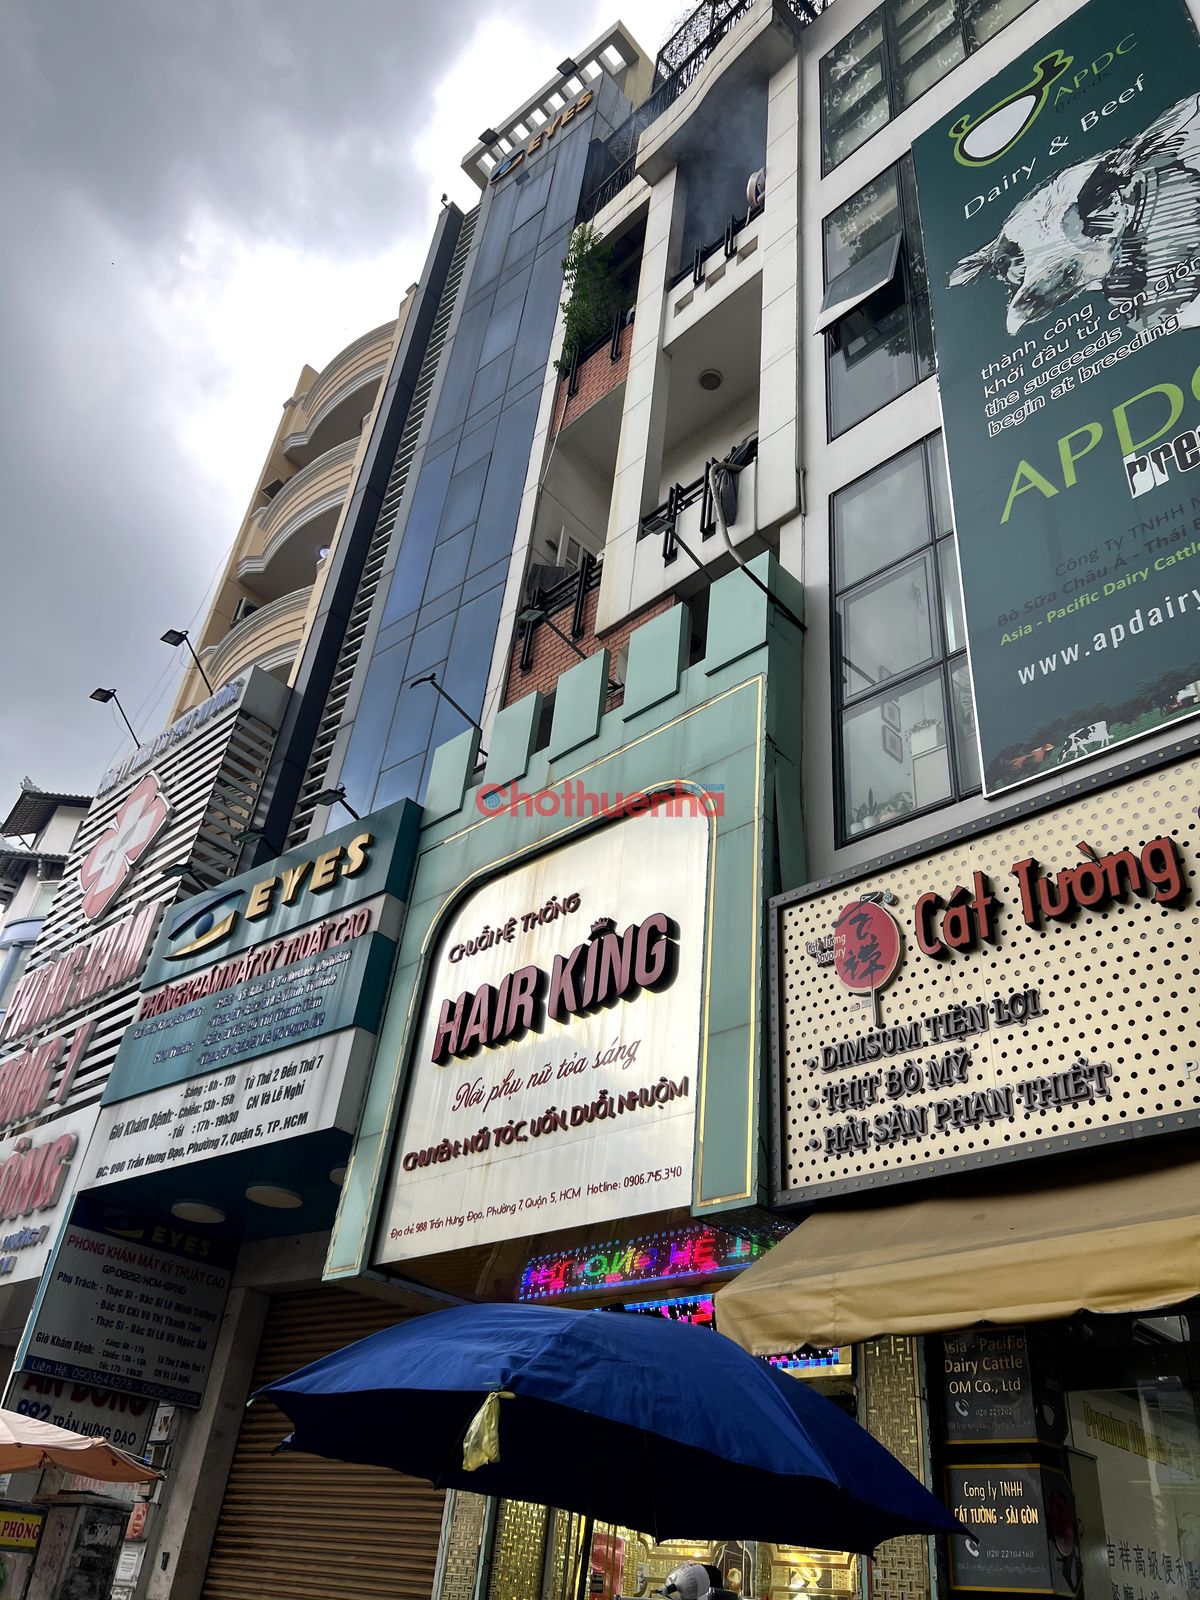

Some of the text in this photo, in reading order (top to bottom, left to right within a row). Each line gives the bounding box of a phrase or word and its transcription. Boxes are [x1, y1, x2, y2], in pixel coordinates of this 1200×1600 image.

[1054, 33, 1138, 106] APDC
[527, 90, 593, 157] EYES
[963, 158, 1038, 220] Dairy
[1048, 136, 1069, 156] &
[1081, 73, 1145, 133] Beef
[981, 304, 1094, 380] thành công
[984, 365, 1024, 398] khởi
[1032, 339, 1070, 368] đầu
[1077, 317, 1100, 340] từ
[1108, 290, 1147, 321] con
[984, 327, 1122, 417] the succeeds
[988, 314, 1180, 438] begin at breeding
[1000, 364, 1200, 525] APD
[1055, 548, 1100, 577] Công
[1104, 536, 1124, 551] Ty
[1128, 503, 1184, 539] TNHH
[1062, 563, 1107, 594] Châu
[1114, 553, 1128, 570] Á
[1143, 524, 1187, 553] Thái
[1000, 624, 1033, 647] Asia
[1046, 591, 1100, 624] Pacific
[1103, 567, 1149, 597] Dairy
[245, 833, 374, 921] EYES
[914, 836, 1185, 958] Cát Tường
[496, 917, 517, 944] HỆ
[521, 892, 581, 933] THỐNG
[139, 984, 186, 1021] PHÒNG
[184, 965, 230, 1003] KHÁM
[284, 921, 337, 967] THUẬT
[334, 908, 372, 945] CAO
[431, 965, 550, 1068] HAIR
[548, 913, 681, 1025] KING
[819, 987, 1044, 1074] DIMSUM TIỆN LỢI
[272, 1068, 280, 1082] 2
[280, 1061, 298, 1080] Đến
[299, 1054, 317, 1074] Thứ
[316, 1054, 325, 1069] 7
[452, 1036, 642, 1113] Nơi phụ nữ tỏa sáng
[822, 1046, 970, 1114] THỊT BÒ MỸ
[123, 1116, 150, 1137] Khám
[203, 1098, 216, 1113] 13h
[220, 1093, 236, 1107] 15h
[246, 1094, 260, 1110] CN
[215, 1110, 240, 1128] 19h30
[823, 1114, 870, 1157] HẢI
[933, 1083, 1014, 1132] PHAN
[1016, 1056, 1112, 1113] THIẾT
[109, 1163, 126, 1175] 990
[126, 1153, 145, 1171] Trần
[186, 1135, 221, 1155] Phường
[229, 1128, 254, 1145] Quận
[266, 1111, 309, 1134] TP.HCM
[445, 1213, 465, 1227] Hưng
[486, 1202, 517, 1216] Phường
[525, 1195, 547, 1209] Quận
[559, 1187, 581, 1201] HCM
[587, 1181, 621, 1196] Hotline:
[623, 1166, 683, 1188] 0906.745.340
[67, 1234, 104, 1256] PHÒNG
[106, 1245, 137, 1265] KHÁM
[206, 1273, 226, 1290] CAO
[151, 1224, 211, 1258] EYES
[57, 1271, 73, 1287] Phụ
[50, 1335, 72, 1350] Khám
[945, 1354, 1023, 1375] Dairy Cattle
[975, 1379, 999, 1394] Co.,
[1002, 1377, 1021, 1392] Ltd
[81, 1420, 111, 1440] HƯNG
[112, 1429, 137, 1448] ĐẠO
[1000, 1481, 1024, 1497] TNHH
[1021, 1504, 1039, 1524] GÒN
